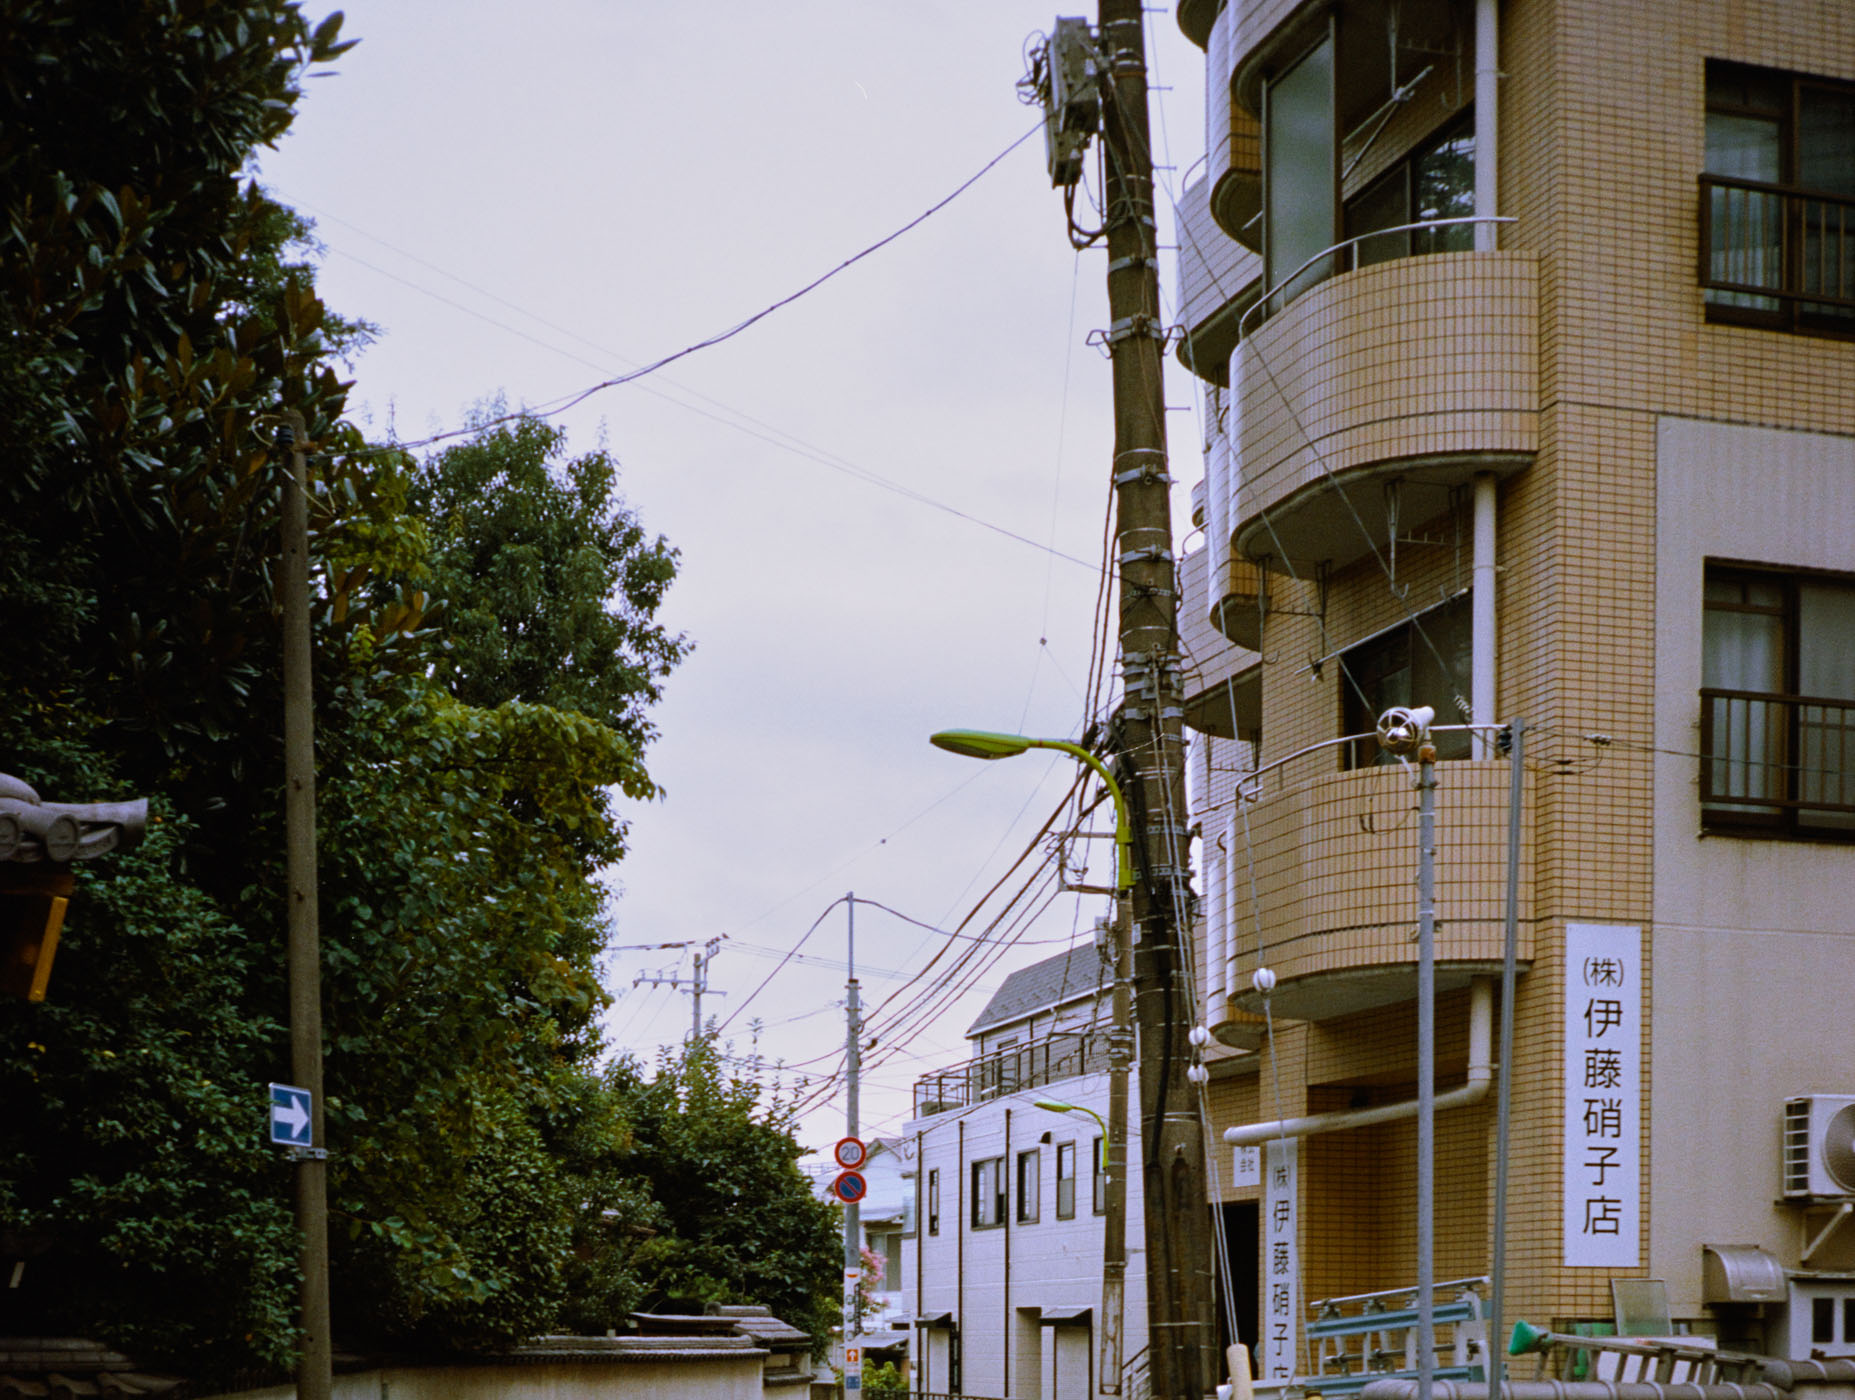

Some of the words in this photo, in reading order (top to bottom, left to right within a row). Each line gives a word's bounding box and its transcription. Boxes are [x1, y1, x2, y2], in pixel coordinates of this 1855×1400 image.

[841, 1146, 860, 1161] 20
[1583, 957, 1624, 1235] (株)伊藤硝子店
